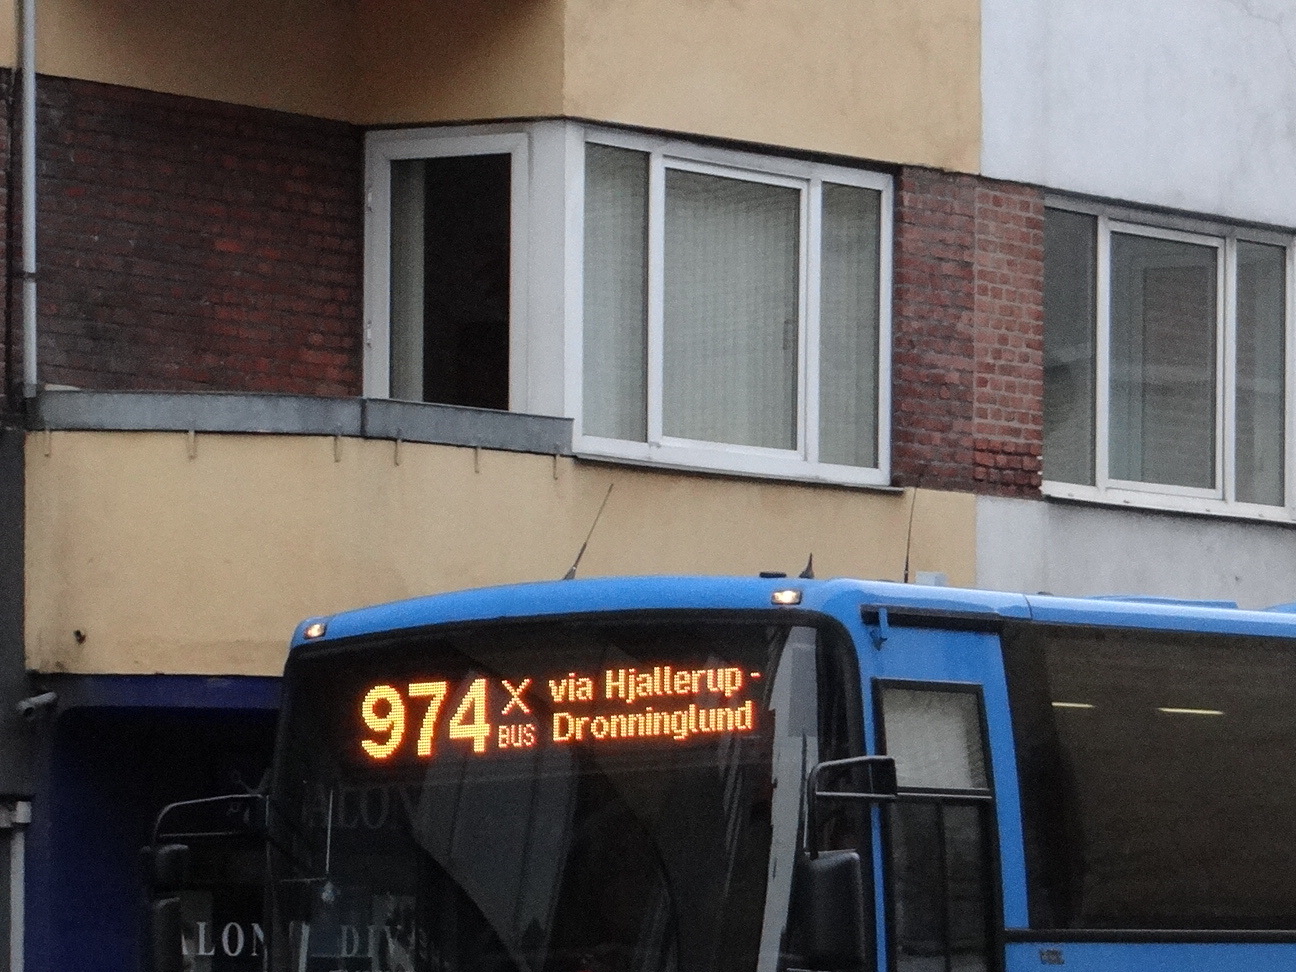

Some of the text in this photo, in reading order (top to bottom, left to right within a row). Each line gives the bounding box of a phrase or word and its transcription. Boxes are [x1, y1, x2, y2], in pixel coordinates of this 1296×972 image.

[500, 678, 532, 715] X
[548, 672, 594, 703] via
[361, 677, 491, 759] 974
[498, 723, 536, 748] BUS
[552, 700, 753, 743] Dronninglund
